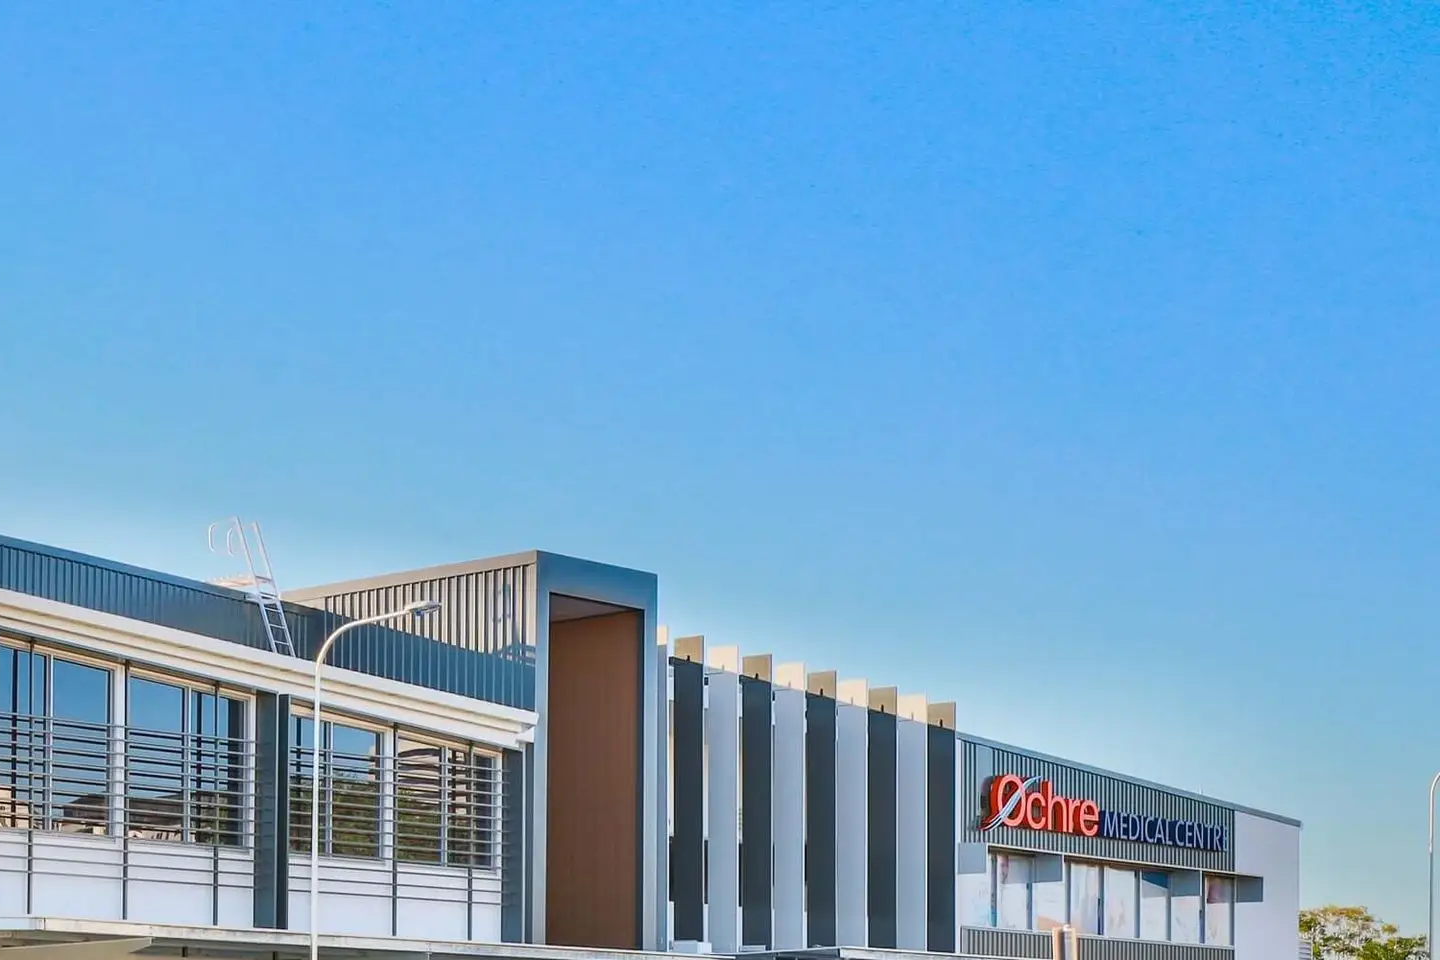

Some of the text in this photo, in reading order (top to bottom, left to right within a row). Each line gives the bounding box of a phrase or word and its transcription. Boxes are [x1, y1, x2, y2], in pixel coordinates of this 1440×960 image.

[997, 773, 1101, 837] Ochre
[1103, 811, 1229, 852] MEDICAL CENTRE
